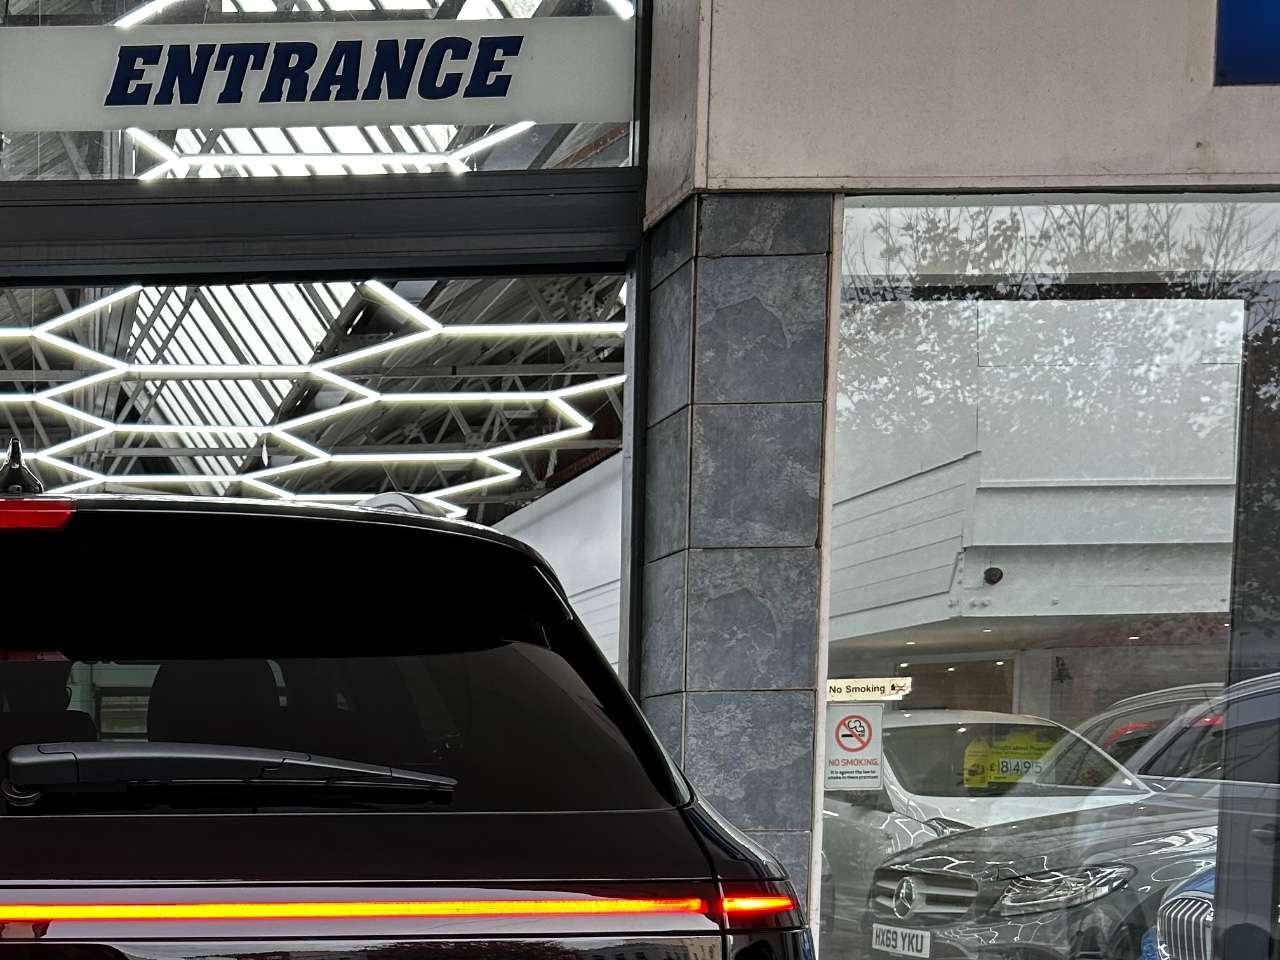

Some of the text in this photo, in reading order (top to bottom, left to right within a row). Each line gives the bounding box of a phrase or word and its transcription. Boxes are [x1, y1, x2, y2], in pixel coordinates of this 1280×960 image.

[104, 35, 524, 106] ENTRANCE
[829, 684, 886, 695] No Smoking
[829, 758, 840, 767] NO
[875, 927, 924, 953] HX69 YKU
